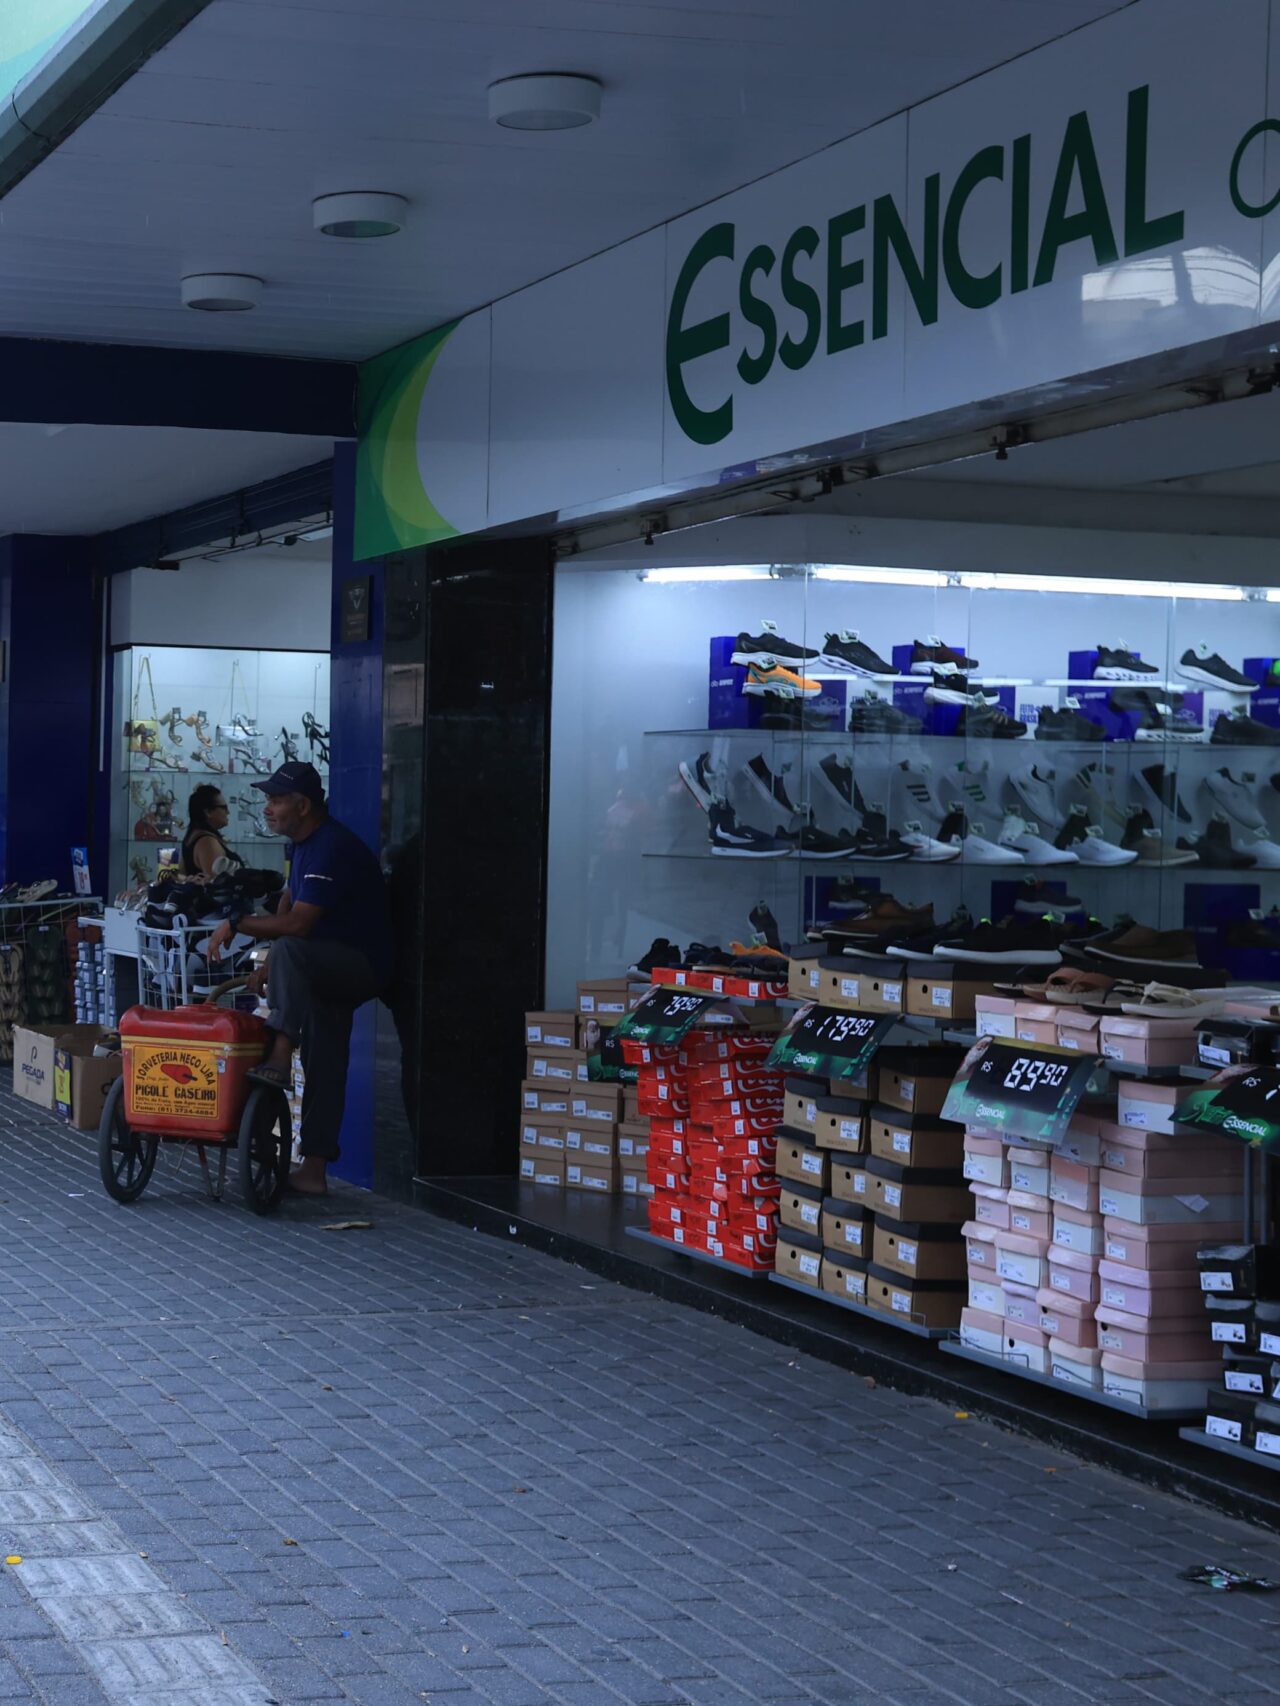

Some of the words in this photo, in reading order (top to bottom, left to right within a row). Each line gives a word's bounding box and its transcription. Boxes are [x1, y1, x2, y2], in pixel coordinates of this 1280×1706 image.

[666, 84, 1184, 445] ESSENCIAL
[22, 1063, 45, 1080] PEGADA
[136, 1052, 177, 1081] SORVETERIA
[179, 1052, 202, 1068] NECO
[200, 1064, 216, 1085] LIRA
[174, 1087, 216, 1101] CASEIRO
[1222, 1115, 1267, 1136] ESSENCIAL
